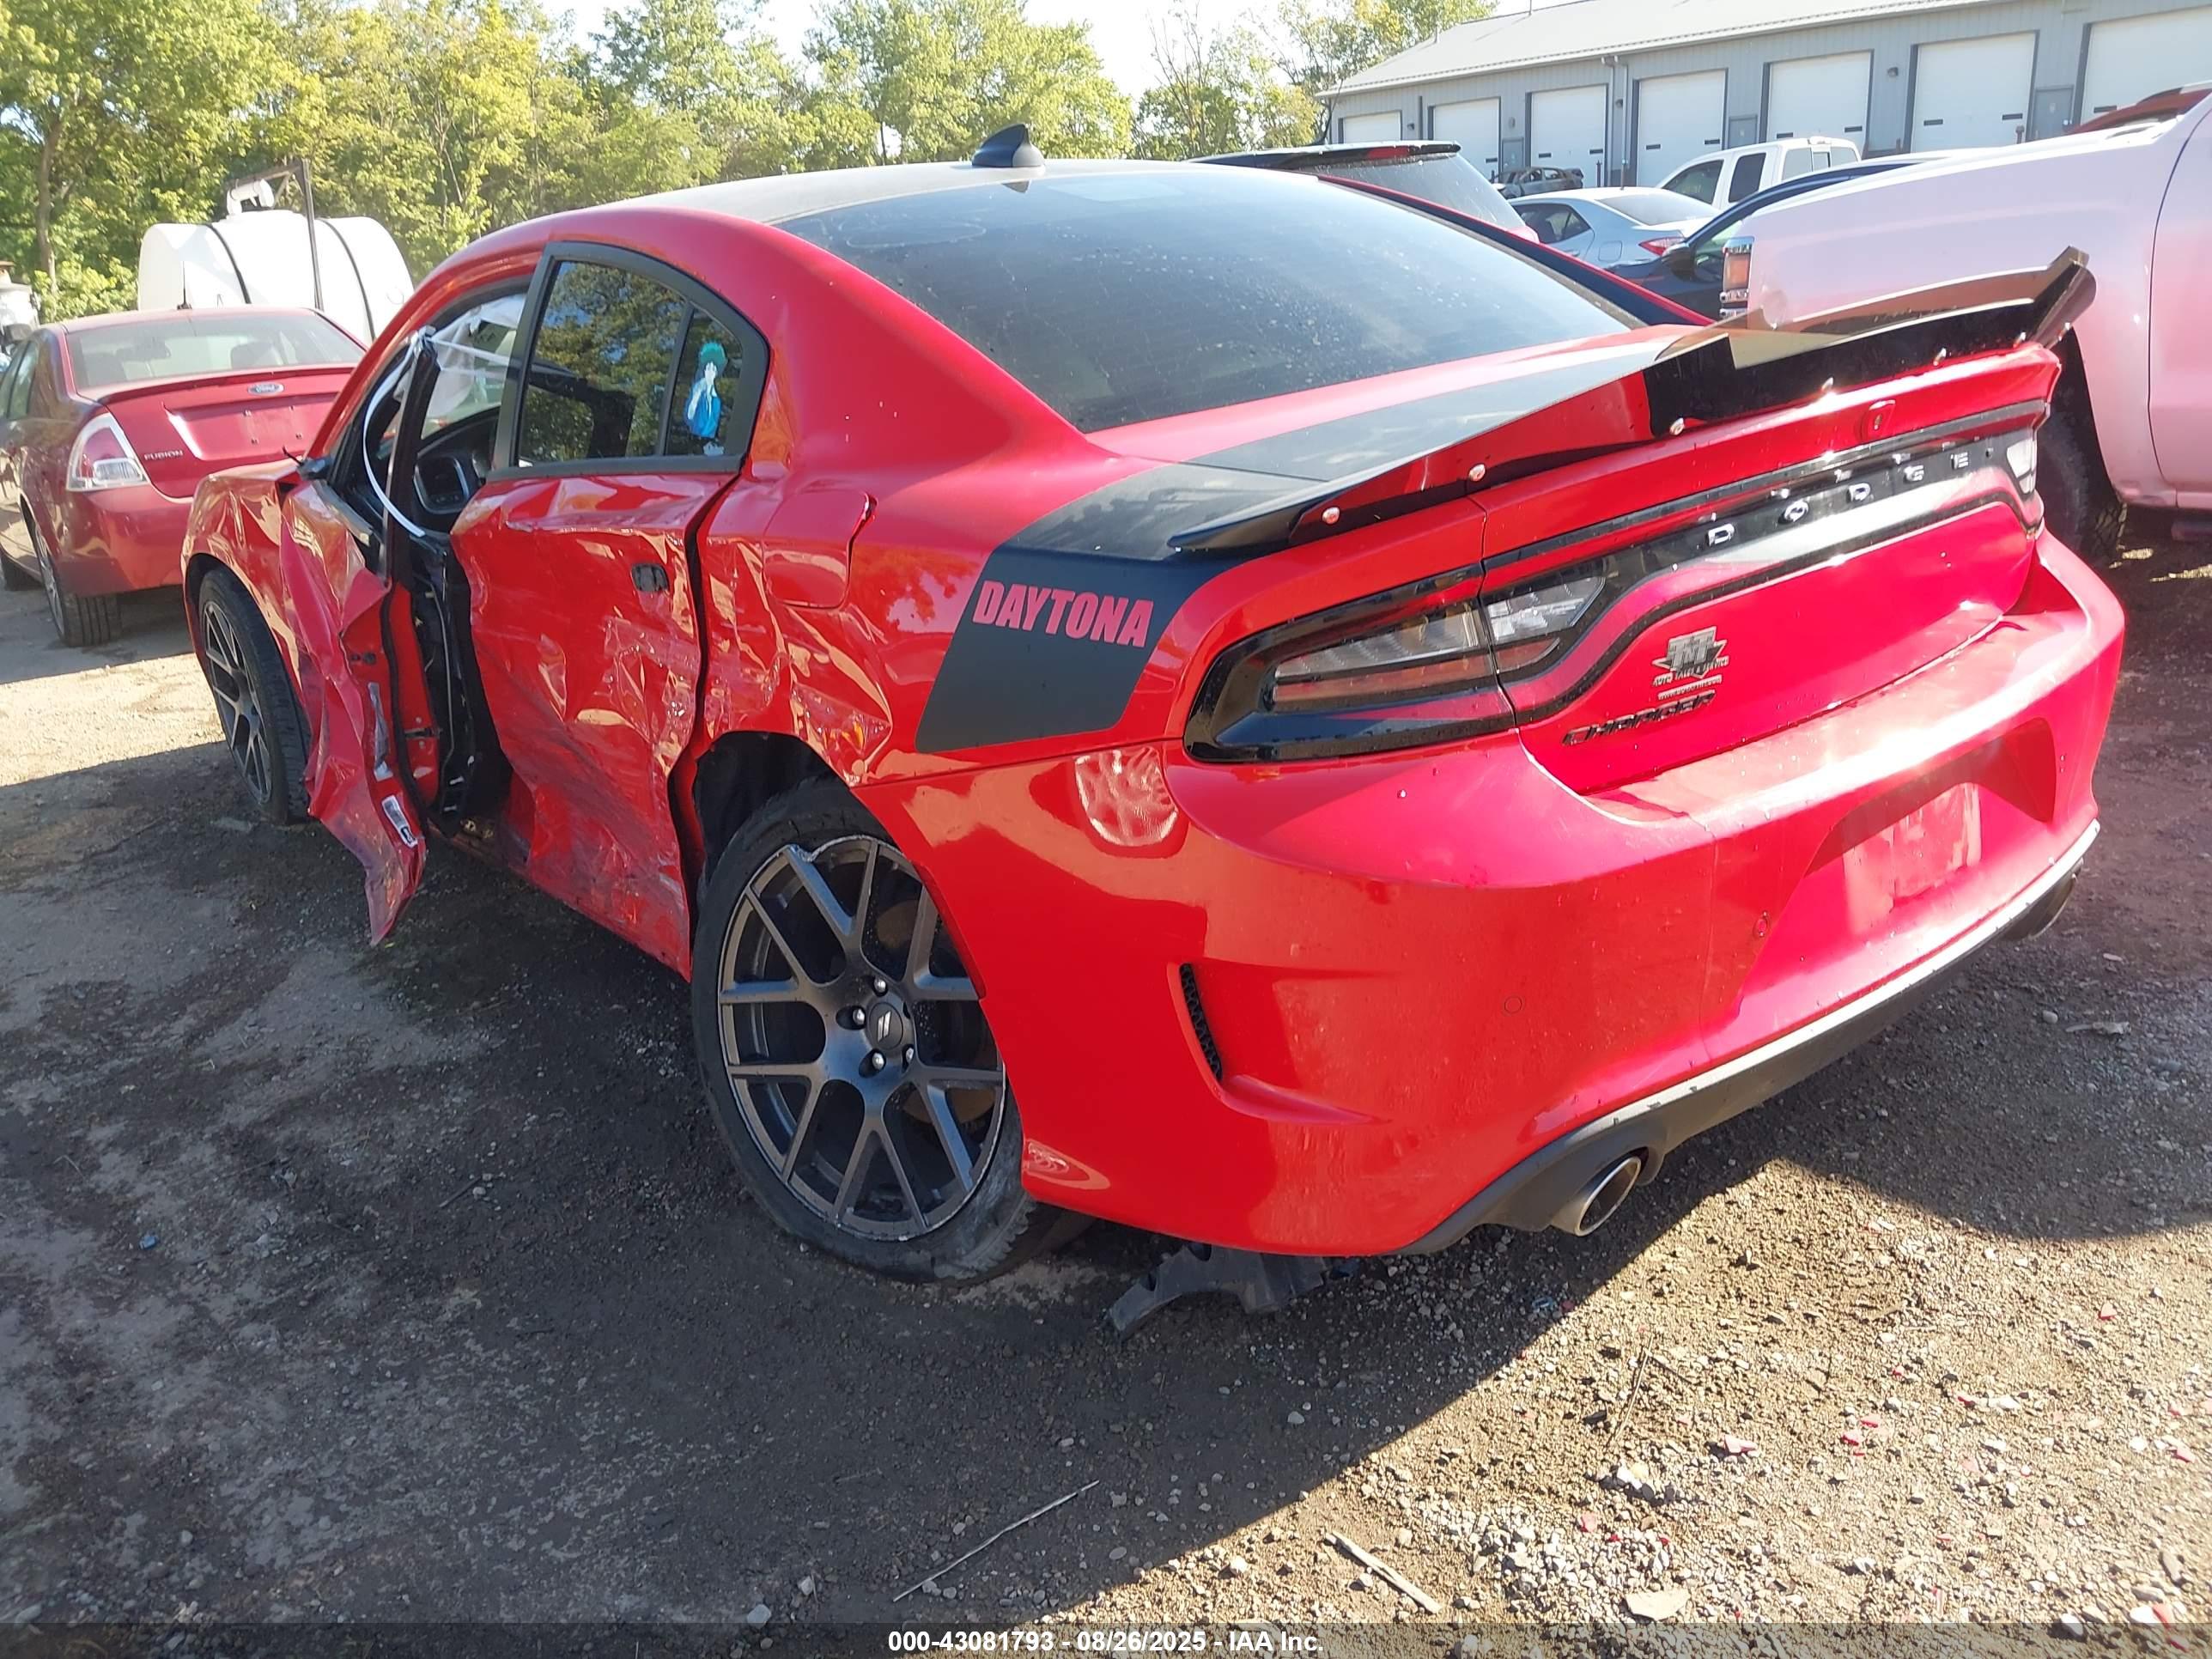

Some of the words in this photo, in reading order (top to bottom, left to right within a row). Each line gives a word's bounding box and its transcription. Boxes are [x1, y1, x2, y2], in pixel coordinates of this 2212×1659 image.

[143, 449, 184, 461] FUSION
[1706, 451, 1970, 546] DODGE
[972, 580, 1155, 647] DAYTONA
[1668, 628, 1715, 670] TNT
[1653, 672, 1674, 687] AUTO
[1562, 690, 1716, 746] CHARGER
